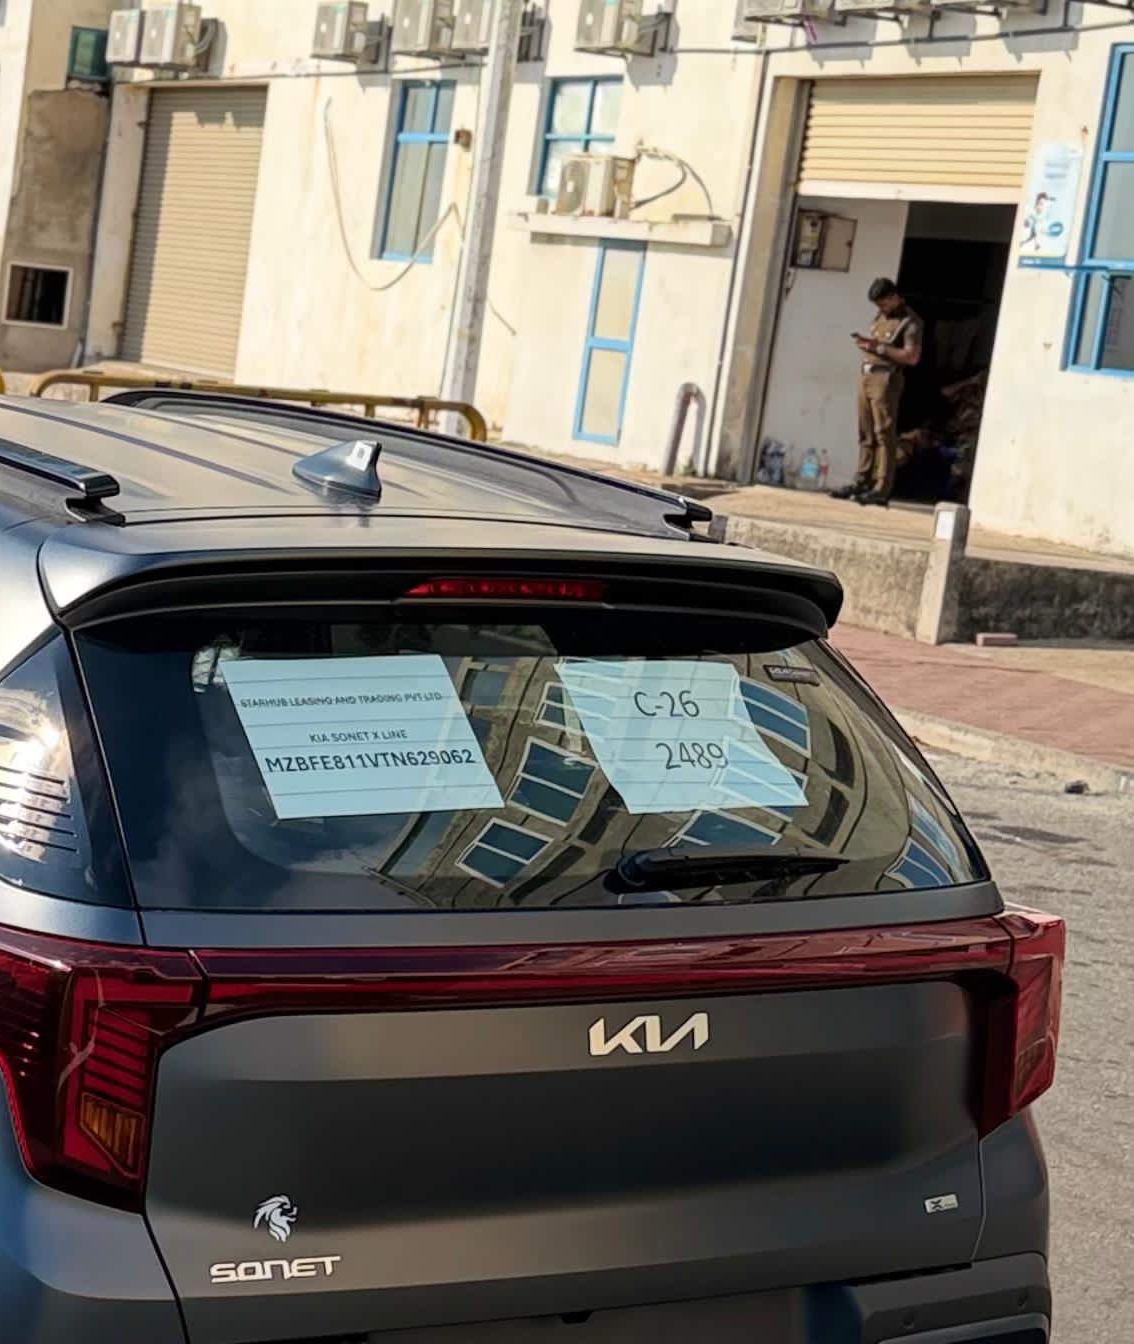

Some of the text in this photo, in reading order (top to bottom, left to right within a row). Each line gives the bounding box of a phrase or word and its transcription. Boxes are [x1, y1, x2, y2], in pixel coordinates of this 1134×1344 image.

[290, 696, 332, 707] LEASING
[335, 695, 356, 705] AND
[358, 693, 403, 704] TRADING
[425, 691, 443, 701] LTD
[634, 690, 700, 718] C-26
[309, 729, 408, 743] KIA SONET X LINE
[656, 742, 729, 770] 2489
[589, 1012, 709, 1056] KIA
[209, 1255, 341, 1283] SONET
